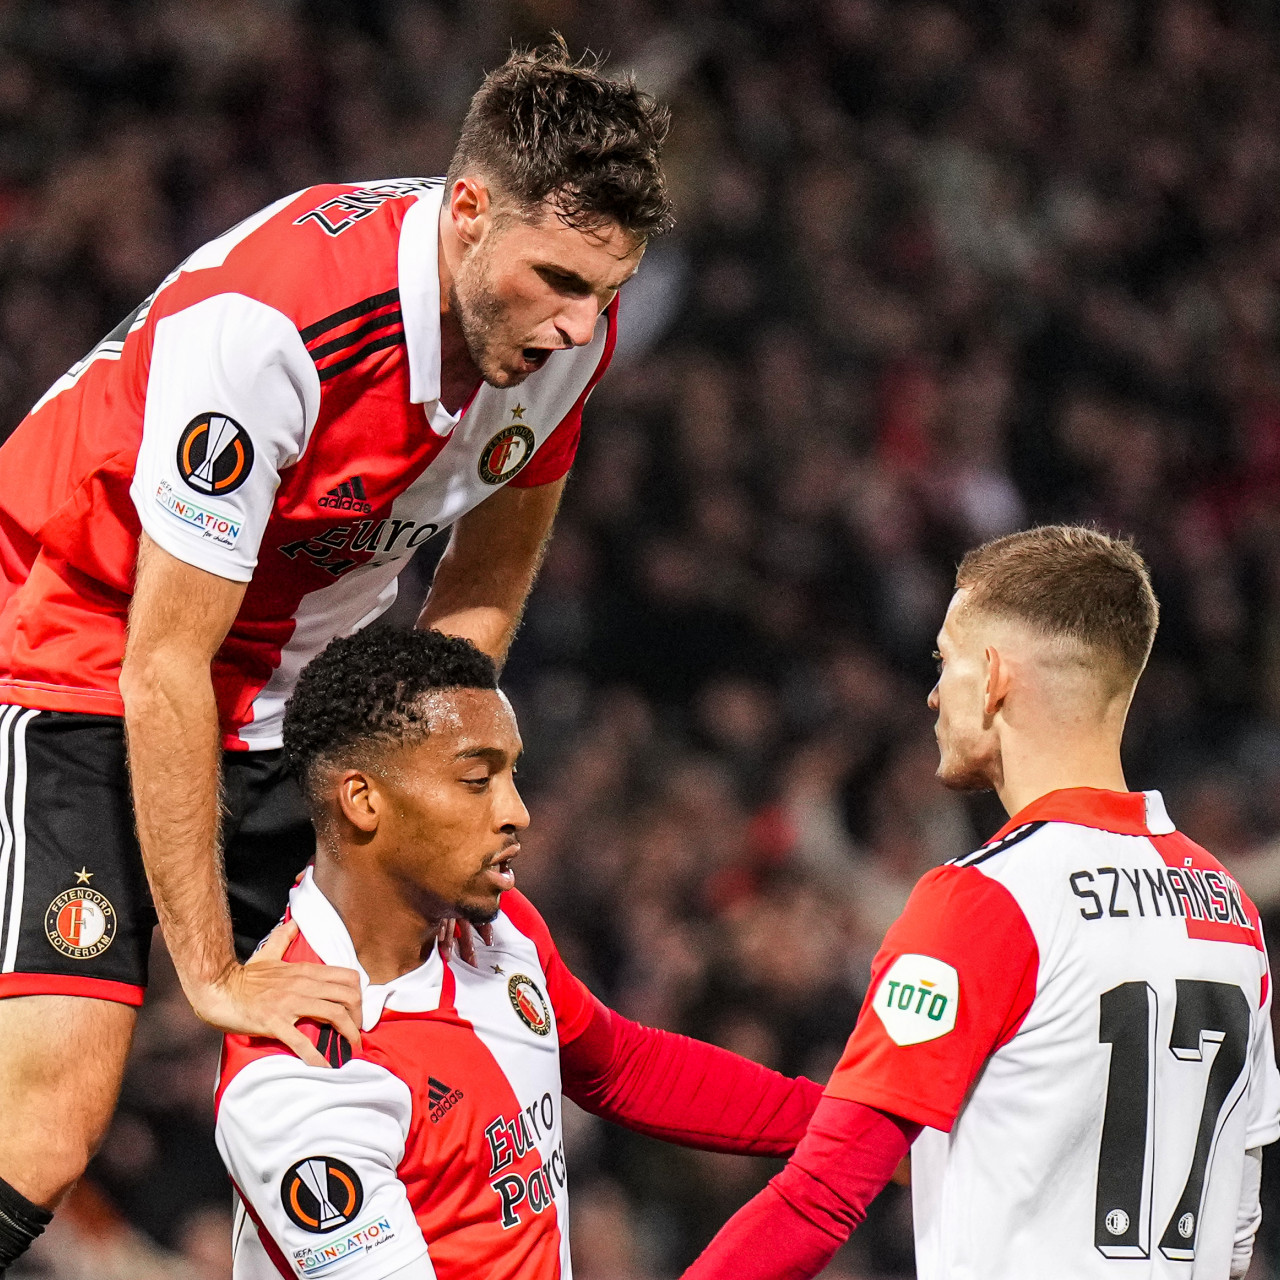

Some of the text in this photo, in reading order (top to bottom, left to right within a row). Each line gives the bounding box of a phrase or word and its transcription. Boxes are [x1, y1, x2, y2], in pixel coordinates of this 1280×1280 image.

[318, 496, 372, 513] adidas
[52, 890, 111, 916] FEYENOORD
[1069, 857, 1255, 930] SZYMAŃSK
[50, 930, 111, 957] ROTTERDAM
[887, 980, 948, 1021] TOTO
[430, 1089, 464, 1123] adidas
[1094, 979, 1252, 1261] 17
[485, 1092, 554, 1177] Euro
[490, 1140, 566, 1230] Parc
[293, 1247, 313, 1259] UEFA
[374, 1233, 395, 1246] children
